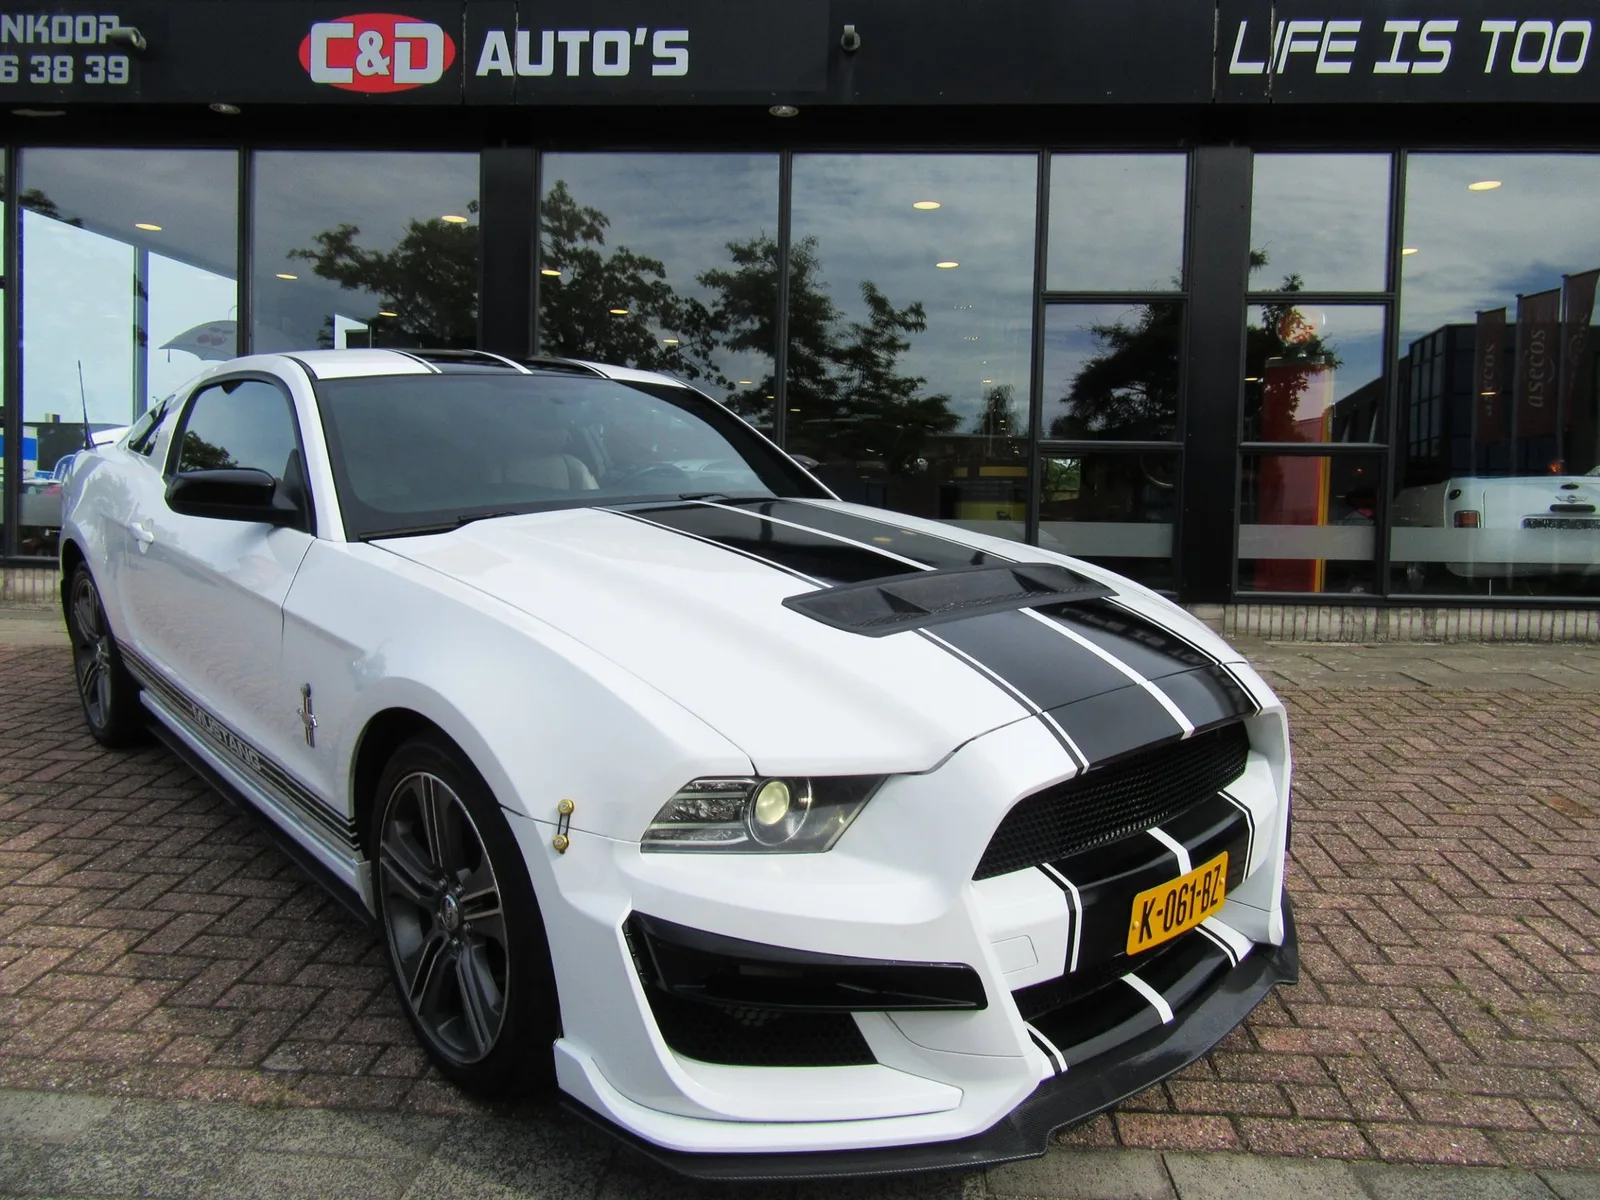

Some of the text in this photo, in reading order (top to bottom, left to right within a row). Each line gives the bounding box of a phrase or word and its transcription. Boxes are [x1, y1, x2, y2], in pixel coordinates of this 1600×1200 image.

[0, 14, 120, 43] NKOOP
[310, 22, 690, 84] C&D AUTO'S
[1229, 20, 1592, 74] LIFE IS TOO
[0, 55, 130, 84] 6 38 39
[1528, 329, 1546, 408] asecos
[1138, 863, 1222, 944] K-061-BZ
